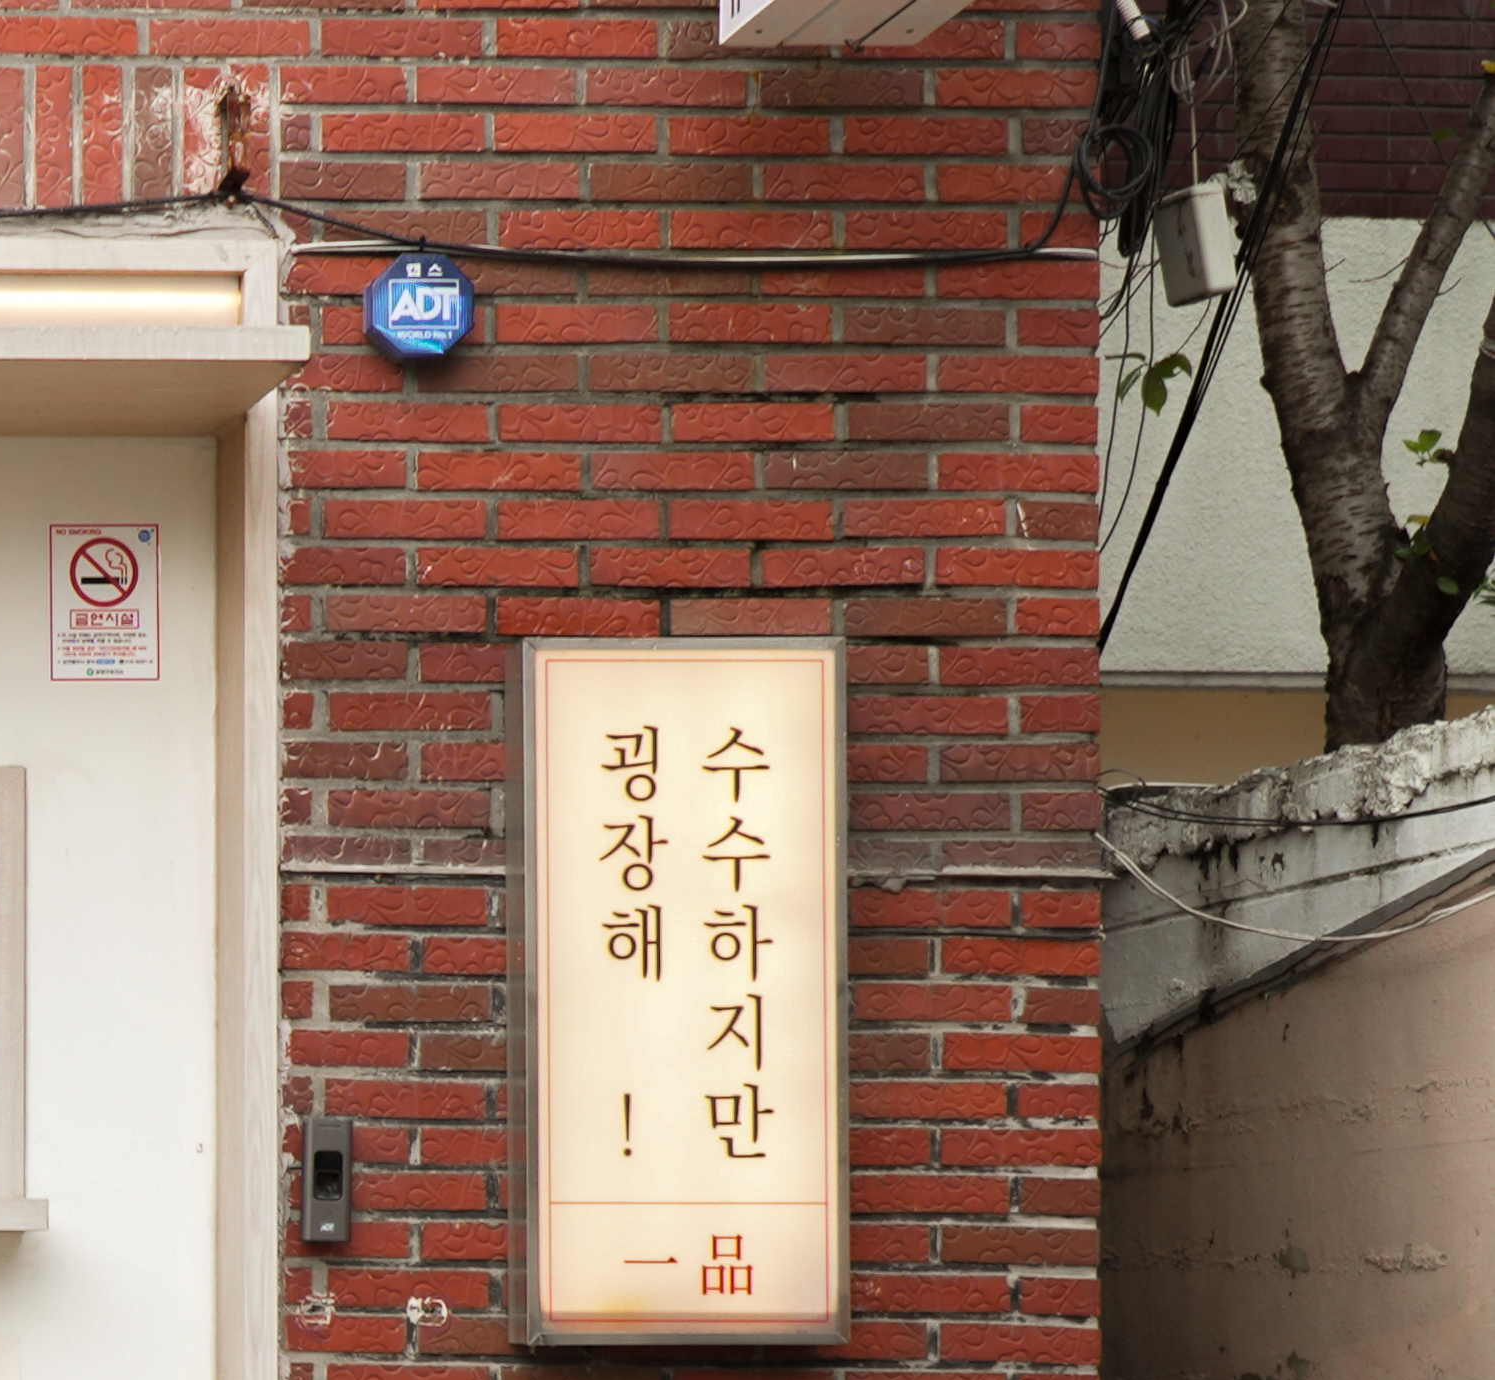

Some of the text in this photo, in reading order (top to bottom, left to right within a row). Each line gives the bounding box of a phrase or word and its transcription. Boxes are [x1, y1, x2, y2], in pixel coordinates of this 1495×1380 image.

[390, 285, 458, 321] ADT
[598, 725, 669, 982] 굉장해
[701, 726, 774, 1160] 수수하지만
